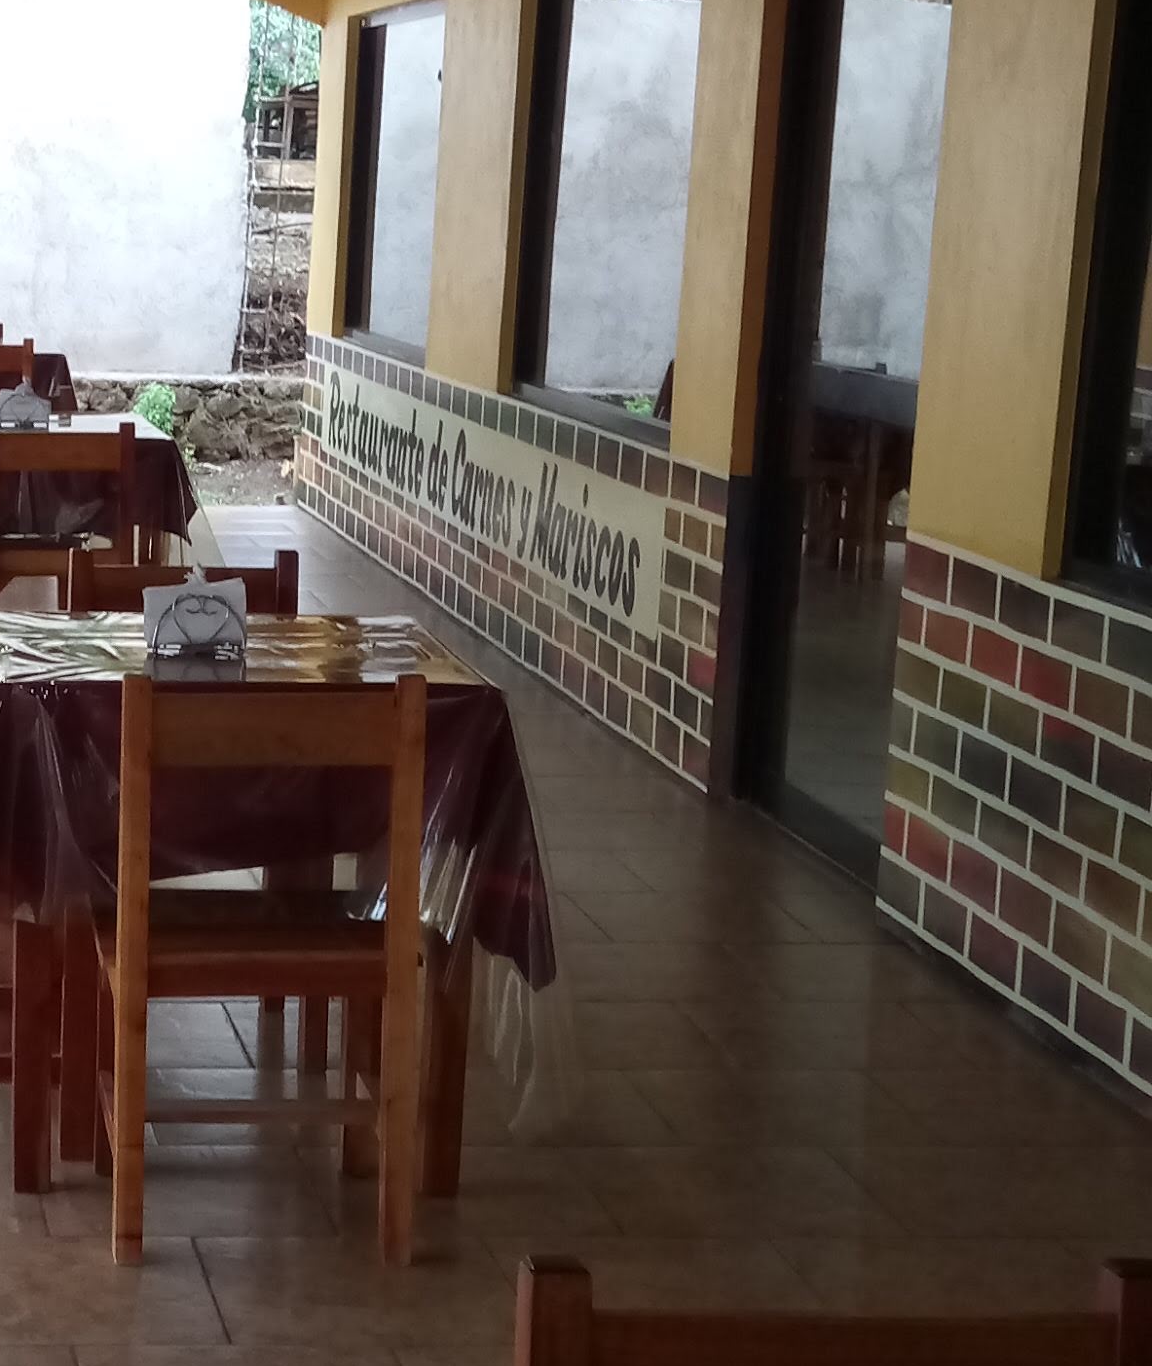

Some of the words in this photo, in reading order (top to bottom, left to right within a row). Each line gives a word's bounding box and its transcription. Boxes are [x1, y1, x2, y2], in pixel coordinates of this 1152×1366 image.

[328, 371, 424, 499] Restaurante
[428, 420, 448, 511] de
[451, 429, 516, 546] Carnes
[517, 486, 532, 559] y
[531, 462, 640, 616] Mariscos
